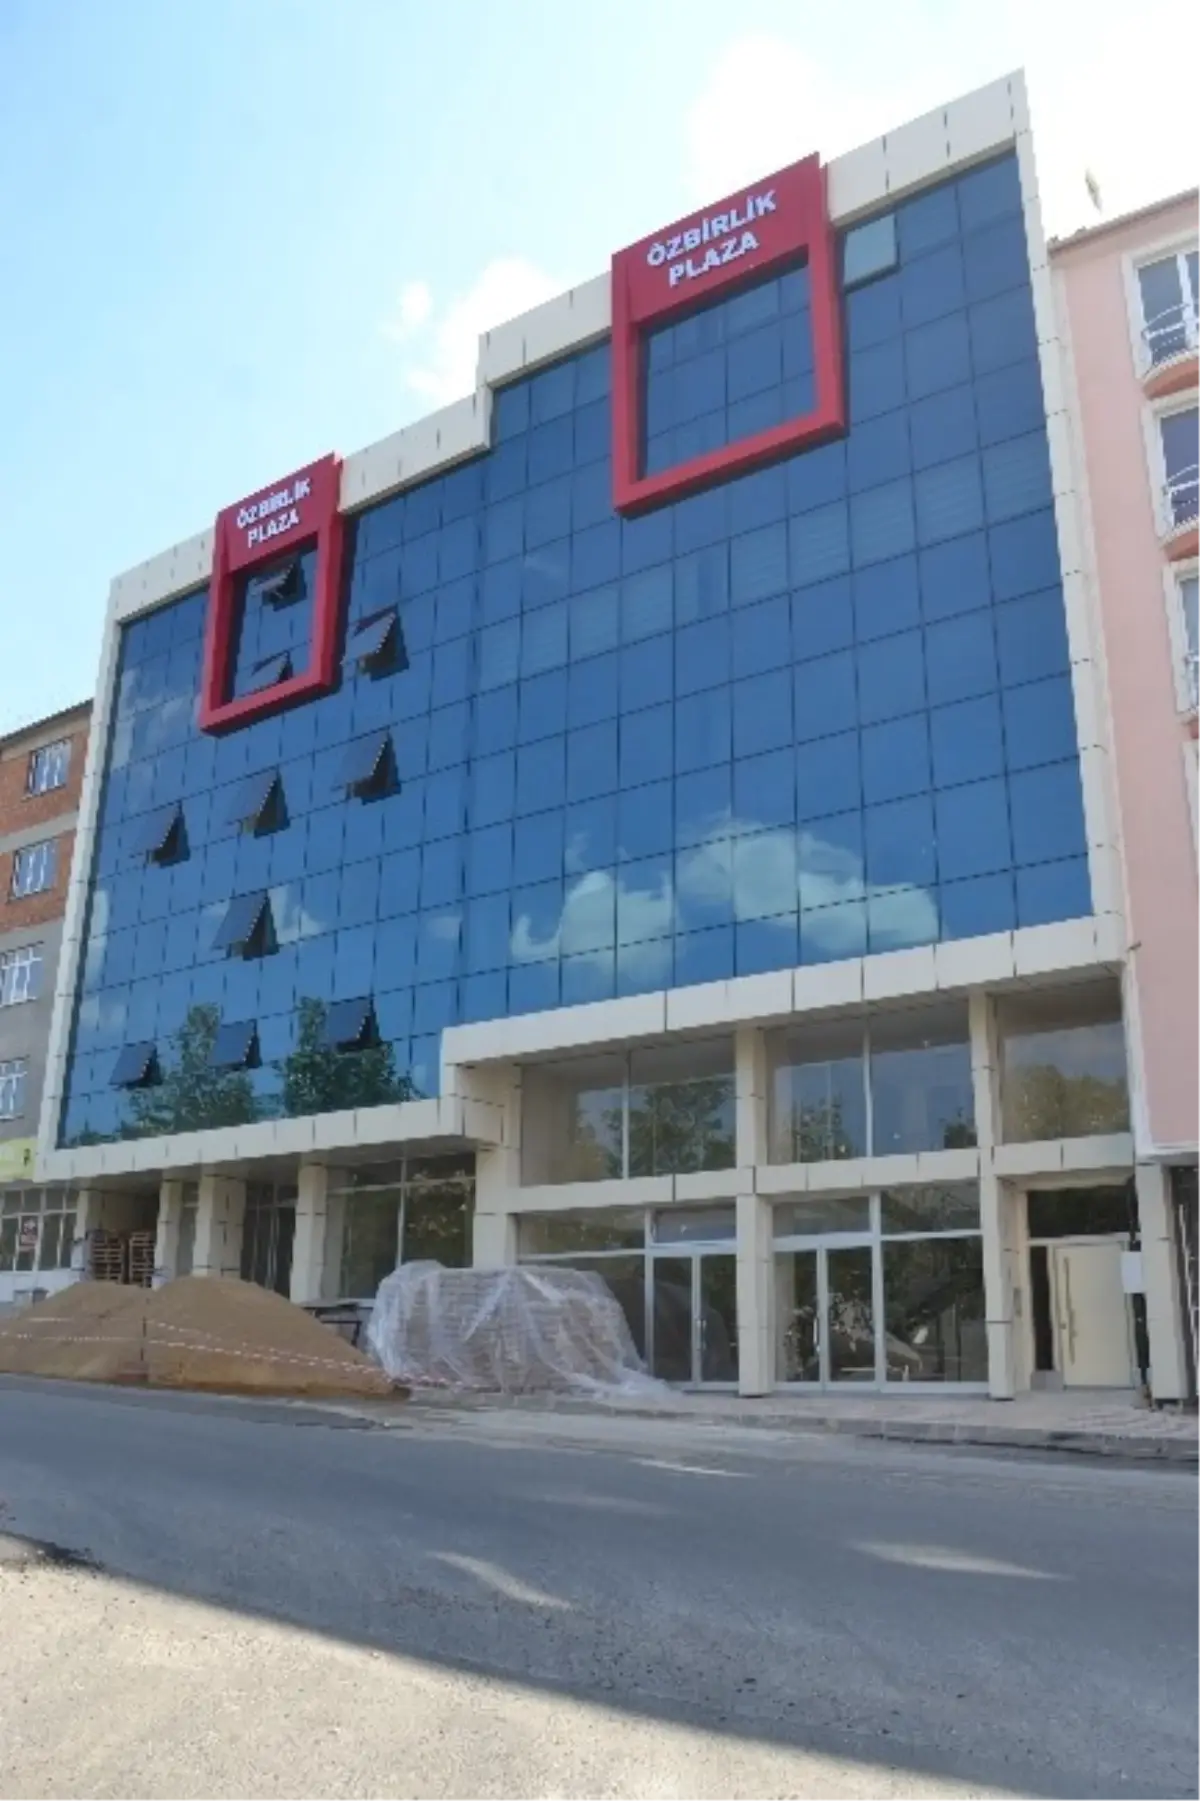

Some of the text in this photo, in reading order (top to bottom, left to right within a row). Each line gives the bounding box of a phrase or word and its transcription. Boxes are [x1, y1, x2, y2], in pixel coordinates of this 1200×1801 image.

[647, 190, 776, 265] ÖZBİRLİK
[669, 232, 760, 287] PLAZA
[248, 508, 299, 548] PLAZA
